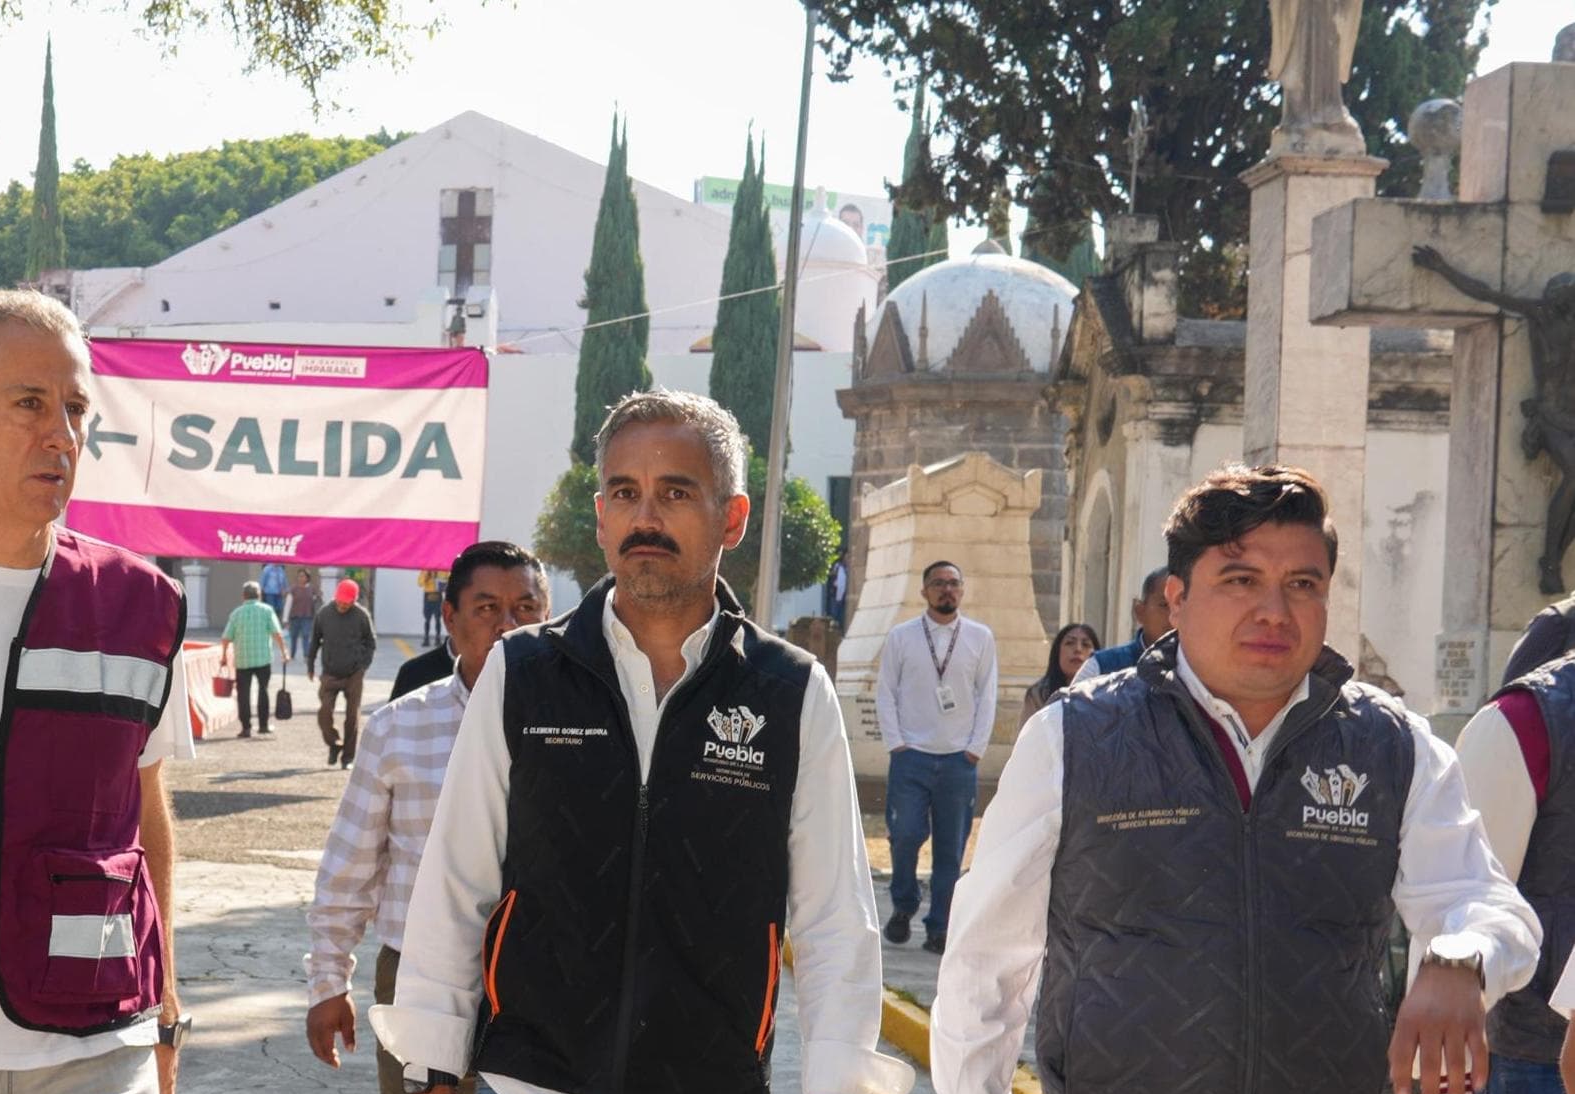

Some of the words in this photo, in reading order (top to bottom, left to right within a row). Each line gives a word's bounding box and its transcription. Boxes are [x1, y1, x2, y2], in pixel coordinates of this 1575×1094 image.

[231, 353, 293, 371] Puebla
[301, 365, 358, 375] IMPARABLE
[167, 413, 462, 480] SALIDA
[222, 541, 297, 556] IMPARABLE
[704, 741, 765, 764] Puebla
[690, 771, 732, 784] SERVICIOS
[733, 776, 770, 791] PÚBLICOS
[1303, 805, 1369, 827] Puebla
